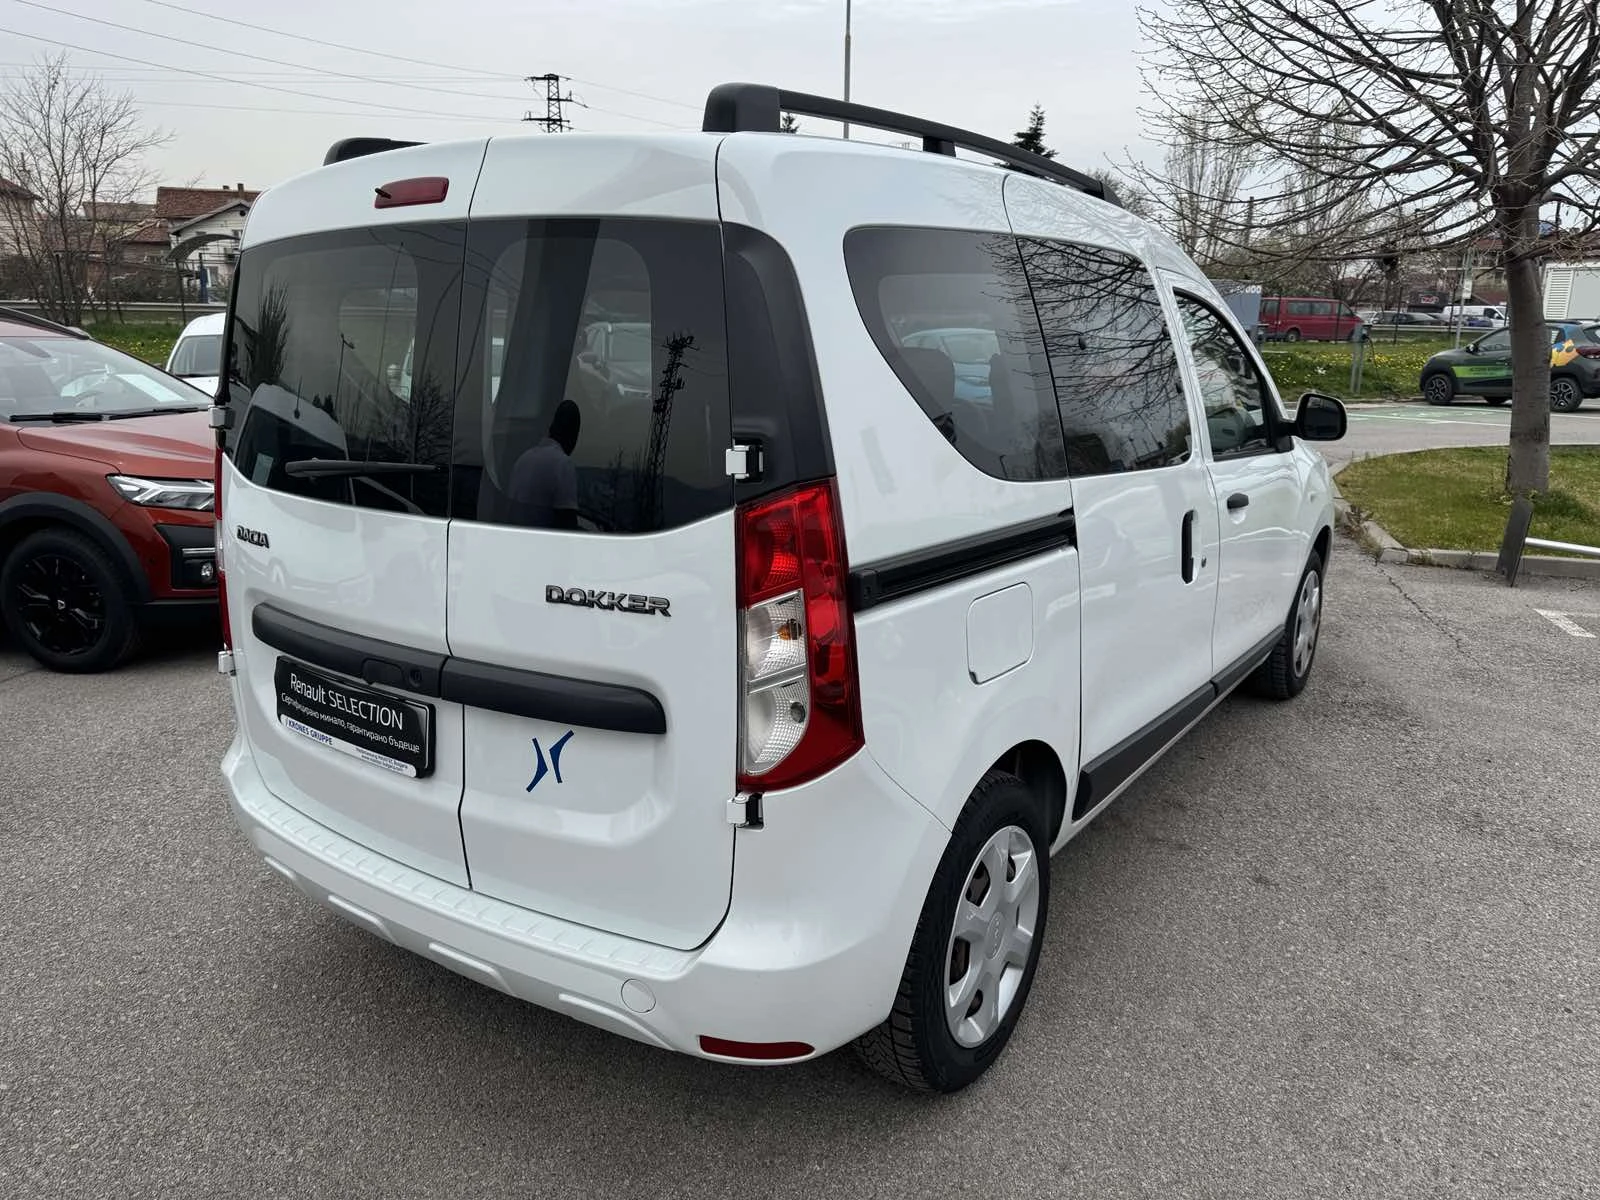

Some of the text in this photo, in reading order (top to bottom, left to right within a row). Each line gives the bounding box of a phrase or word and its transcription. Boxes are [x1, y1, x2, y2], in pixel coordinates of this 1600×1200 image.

[236, 524, 270, 549] DACIA
[545, 584, 672, 617] DOKKER
[290, 672, 404, 730] Renault SELECTION
[310, 729, 333, 746] GRUPPE
